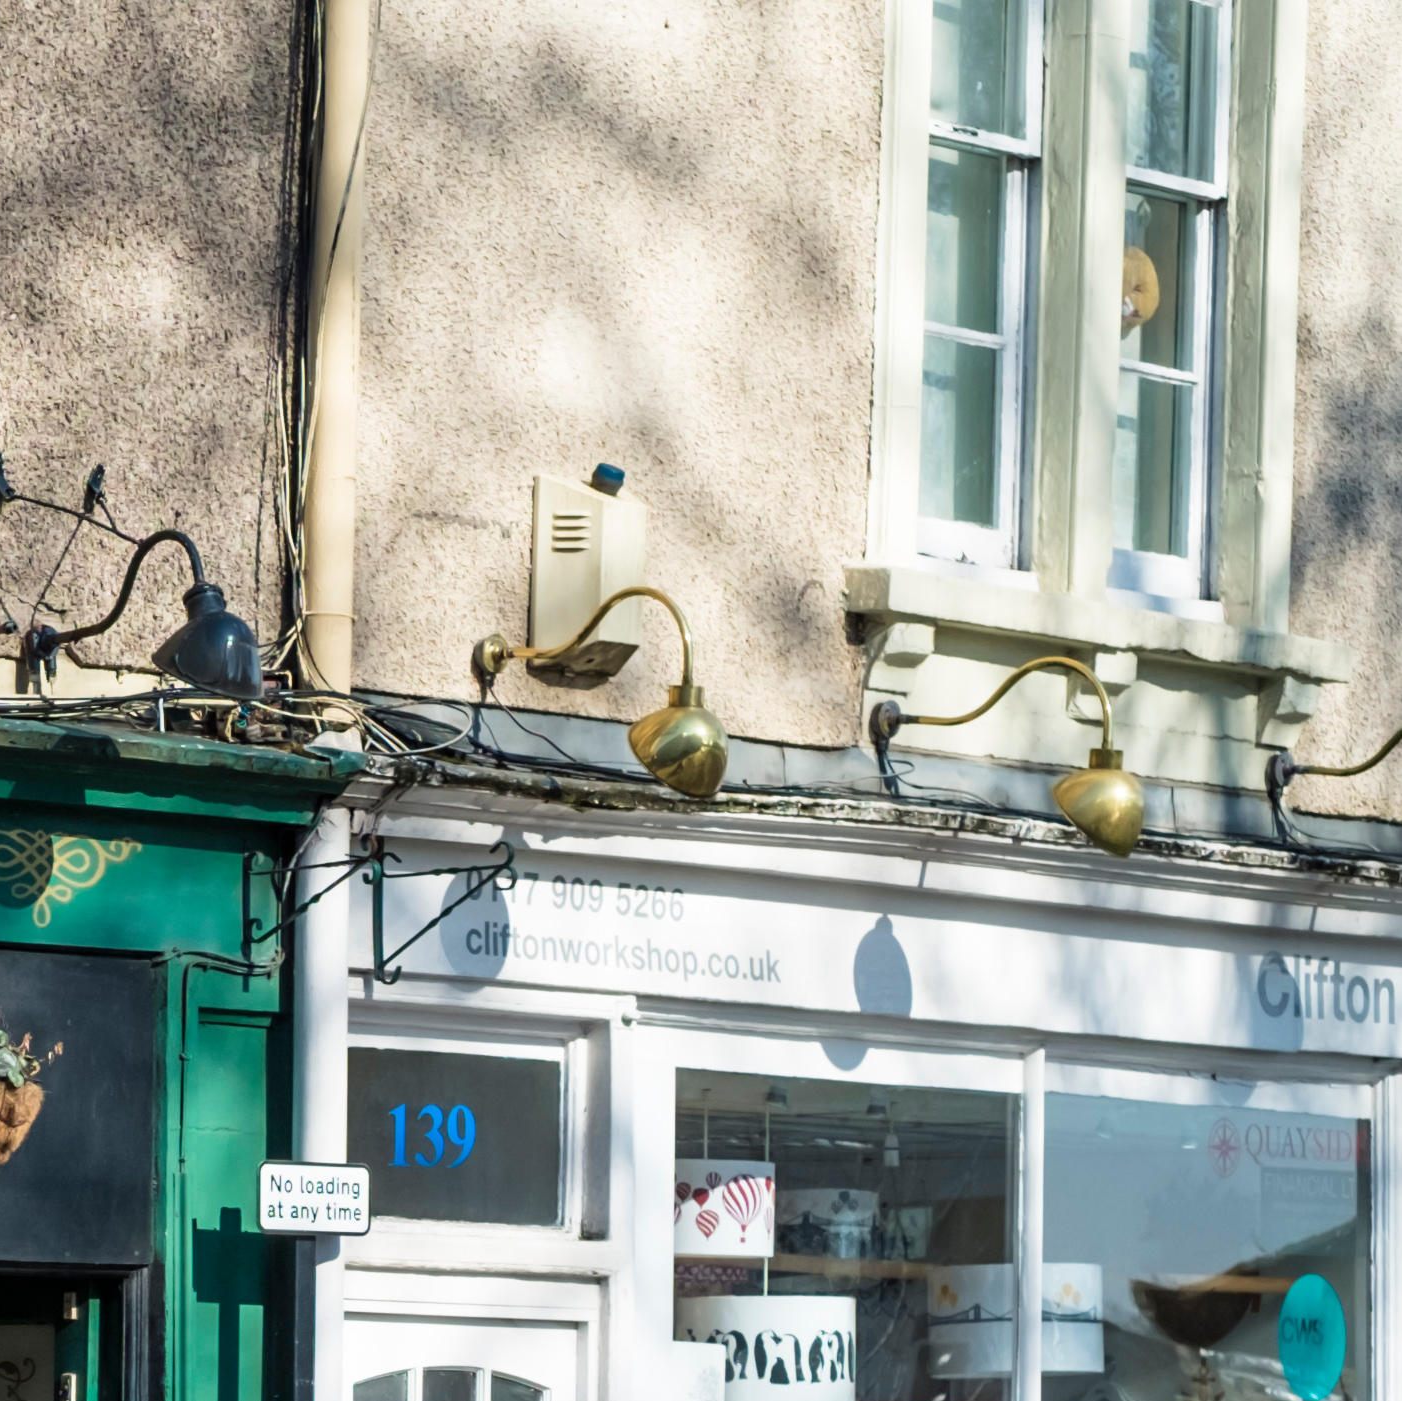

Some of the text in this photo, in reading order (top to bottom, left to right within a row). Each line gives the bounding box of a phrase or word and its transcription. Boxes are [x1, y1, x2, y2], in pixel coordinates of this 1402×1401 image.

[465, 866, 685, 922] 0117 909 5266
[465, 921, 781, 984] cliftonworkshop.co.uk
[1257, 950, 1396, 1025] Clifton
[387, 1102, 476, 1169] 139
[267, 1201, 362, 1223] at any time
[270, 1173, 360, 1200] No loading
